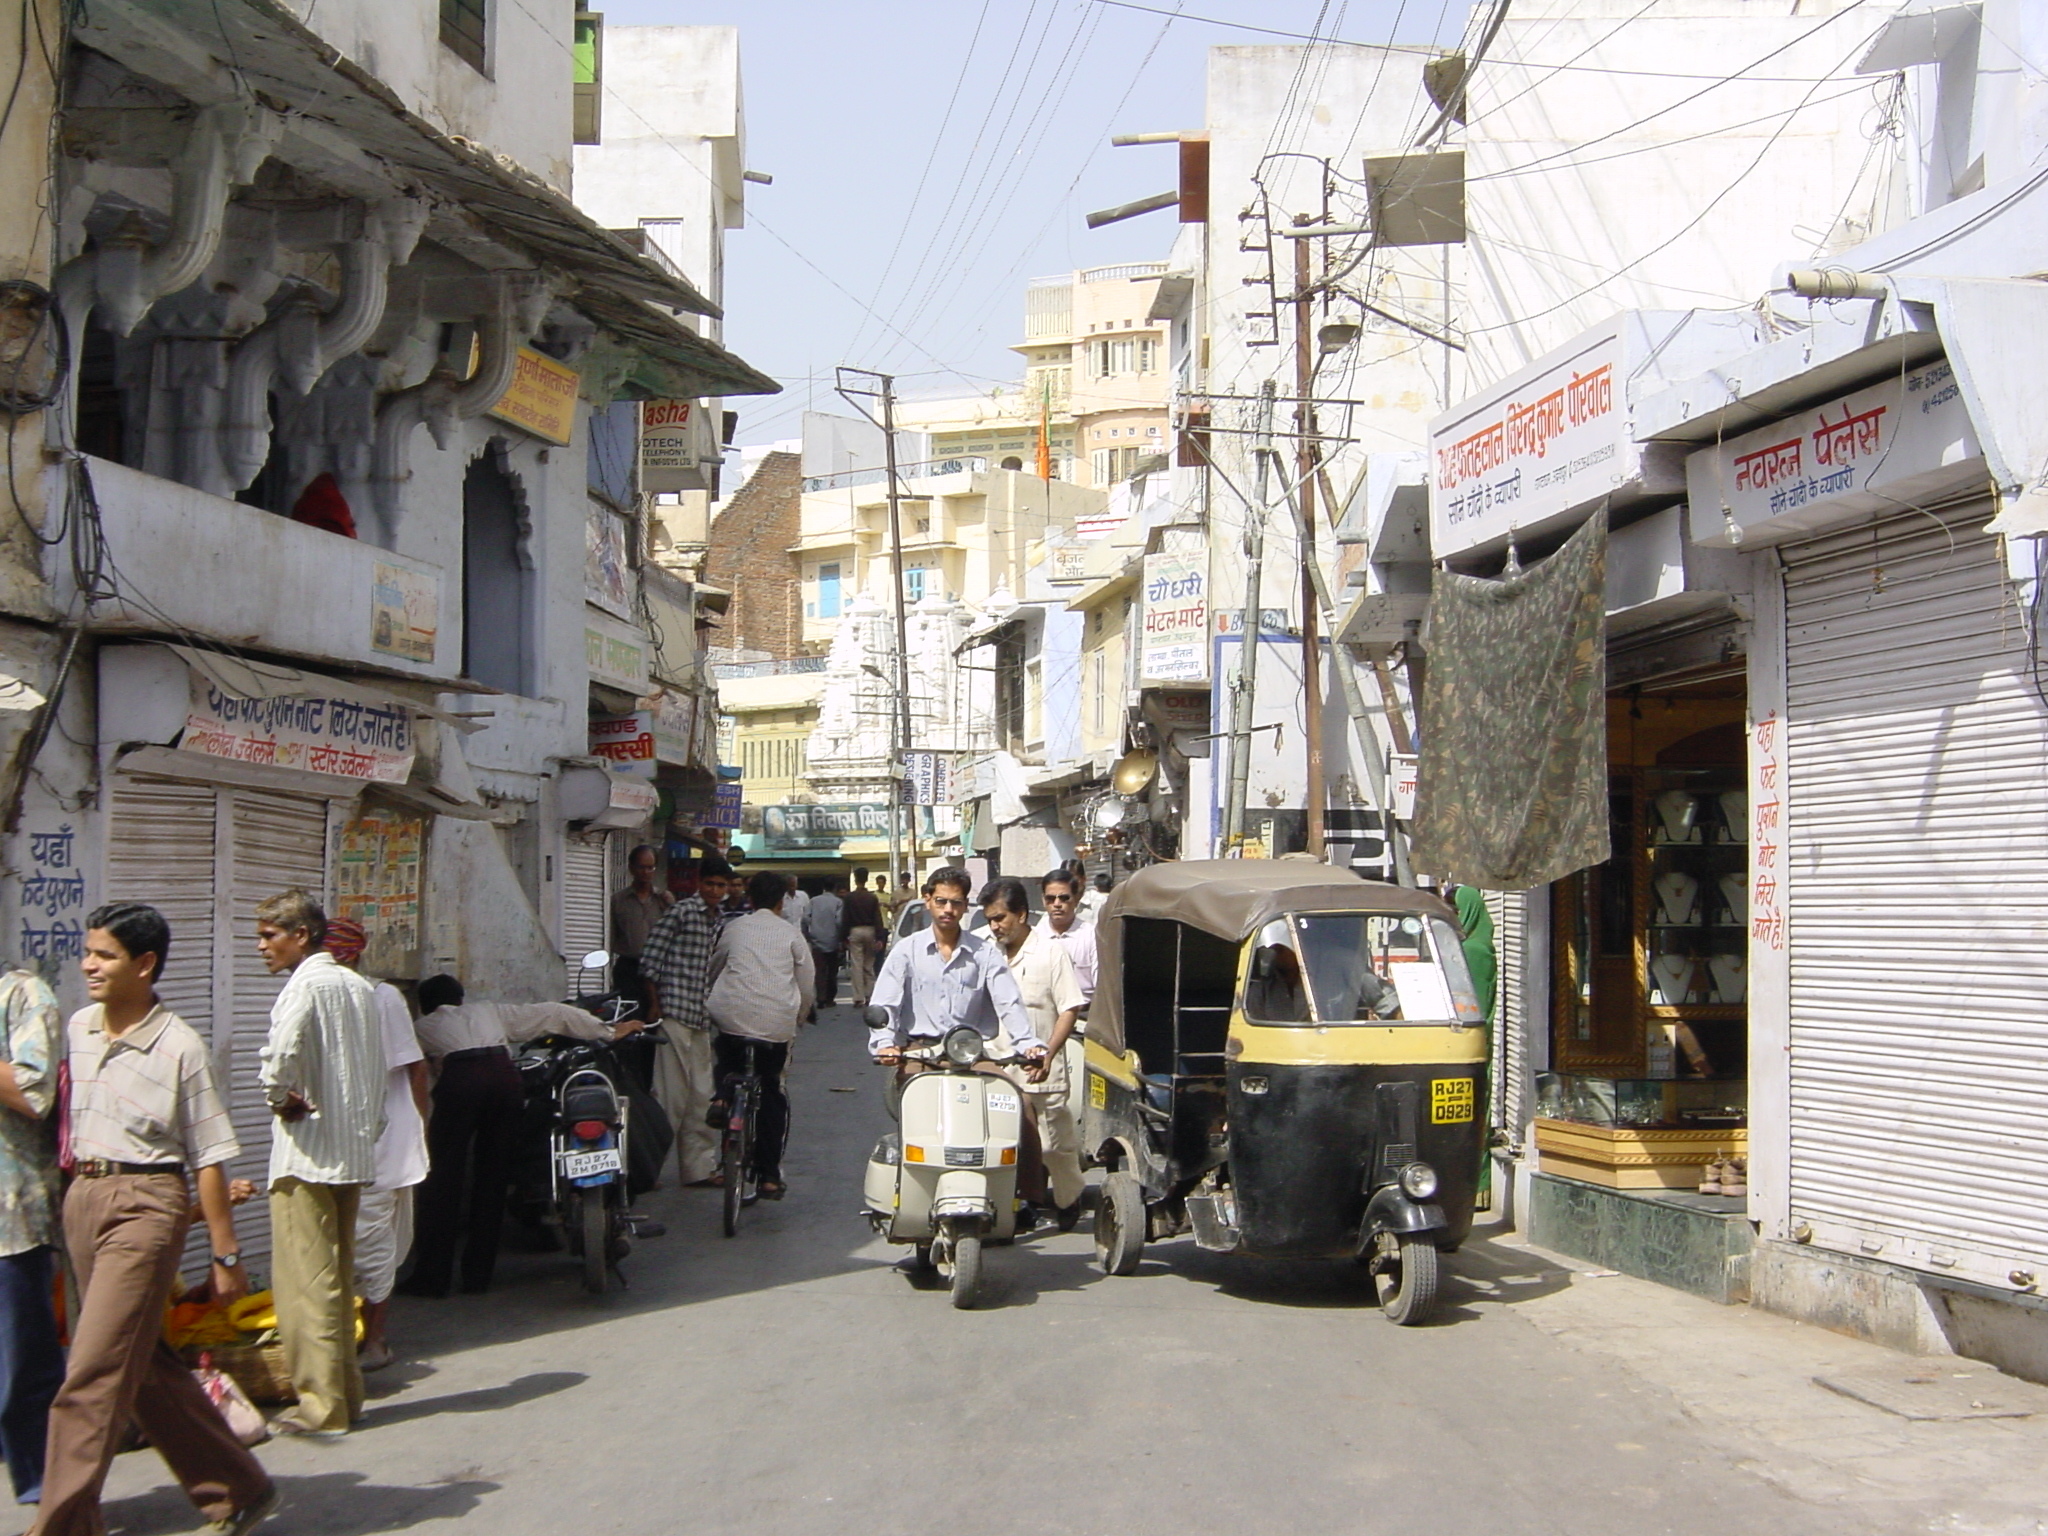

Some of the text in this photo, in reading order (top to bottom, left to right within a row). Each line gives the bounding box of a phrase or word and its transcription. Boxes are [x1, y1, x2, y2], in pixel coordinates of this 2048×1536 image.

[642, 438, 683, 448] OTECH
[1537, 387, 1564, 458] कुमार
[1734, 402, 1886, 491] नवरत्न पेलेस
[1820, 465, 1855, 495] व्यापारी
[1146, 600, 1204, 633] मेटल मार्ट
[591, 732, 655, 761] लस्सी
[920, 754, 931, 803] GRAPHICS
[785, 808, 809, 831] रंग
[812, 806, 856, 830] निवास
[29, 823, 75, 868] यहाँ
[47, 868, 85, 917] पुराने
[51, 919, 83, 961] लिये
